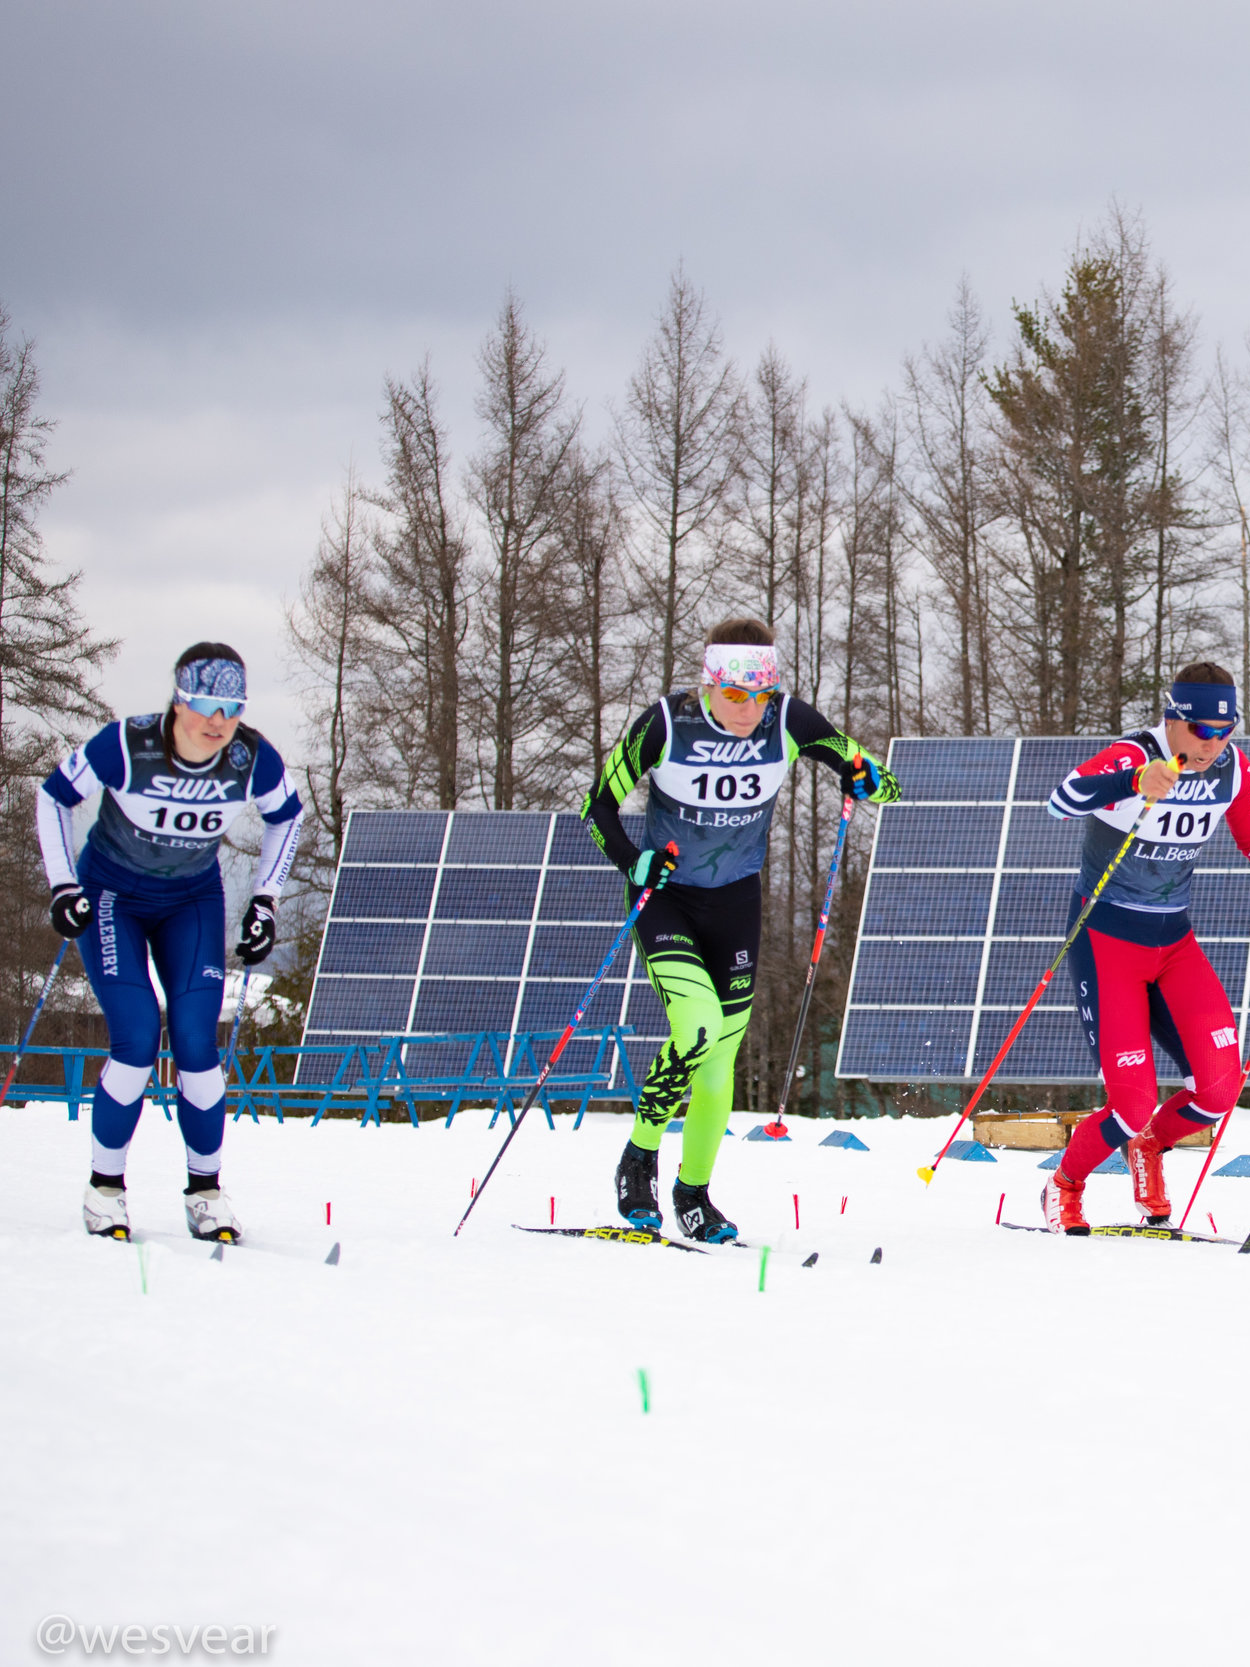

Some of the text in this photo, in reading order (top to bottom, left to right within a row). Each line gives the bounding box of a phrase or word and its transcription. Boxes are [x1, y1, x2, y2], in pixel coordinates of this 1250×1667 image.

[685, 739, 767, 764] SWIX
[143, 775, 238, 800] SWIX
[691, 773, 762, 801] 103
[148, 807, 223, 832] 106
[678, 807, 763, 828] L.L.Bean
[1157, 811, 1212, 838] 101
[134, 829, 215, 850] L.L.Bea
[583, 1228, 653, 1246] FISCHER
[1090, 1226, 1172, 1241] FISCHER
